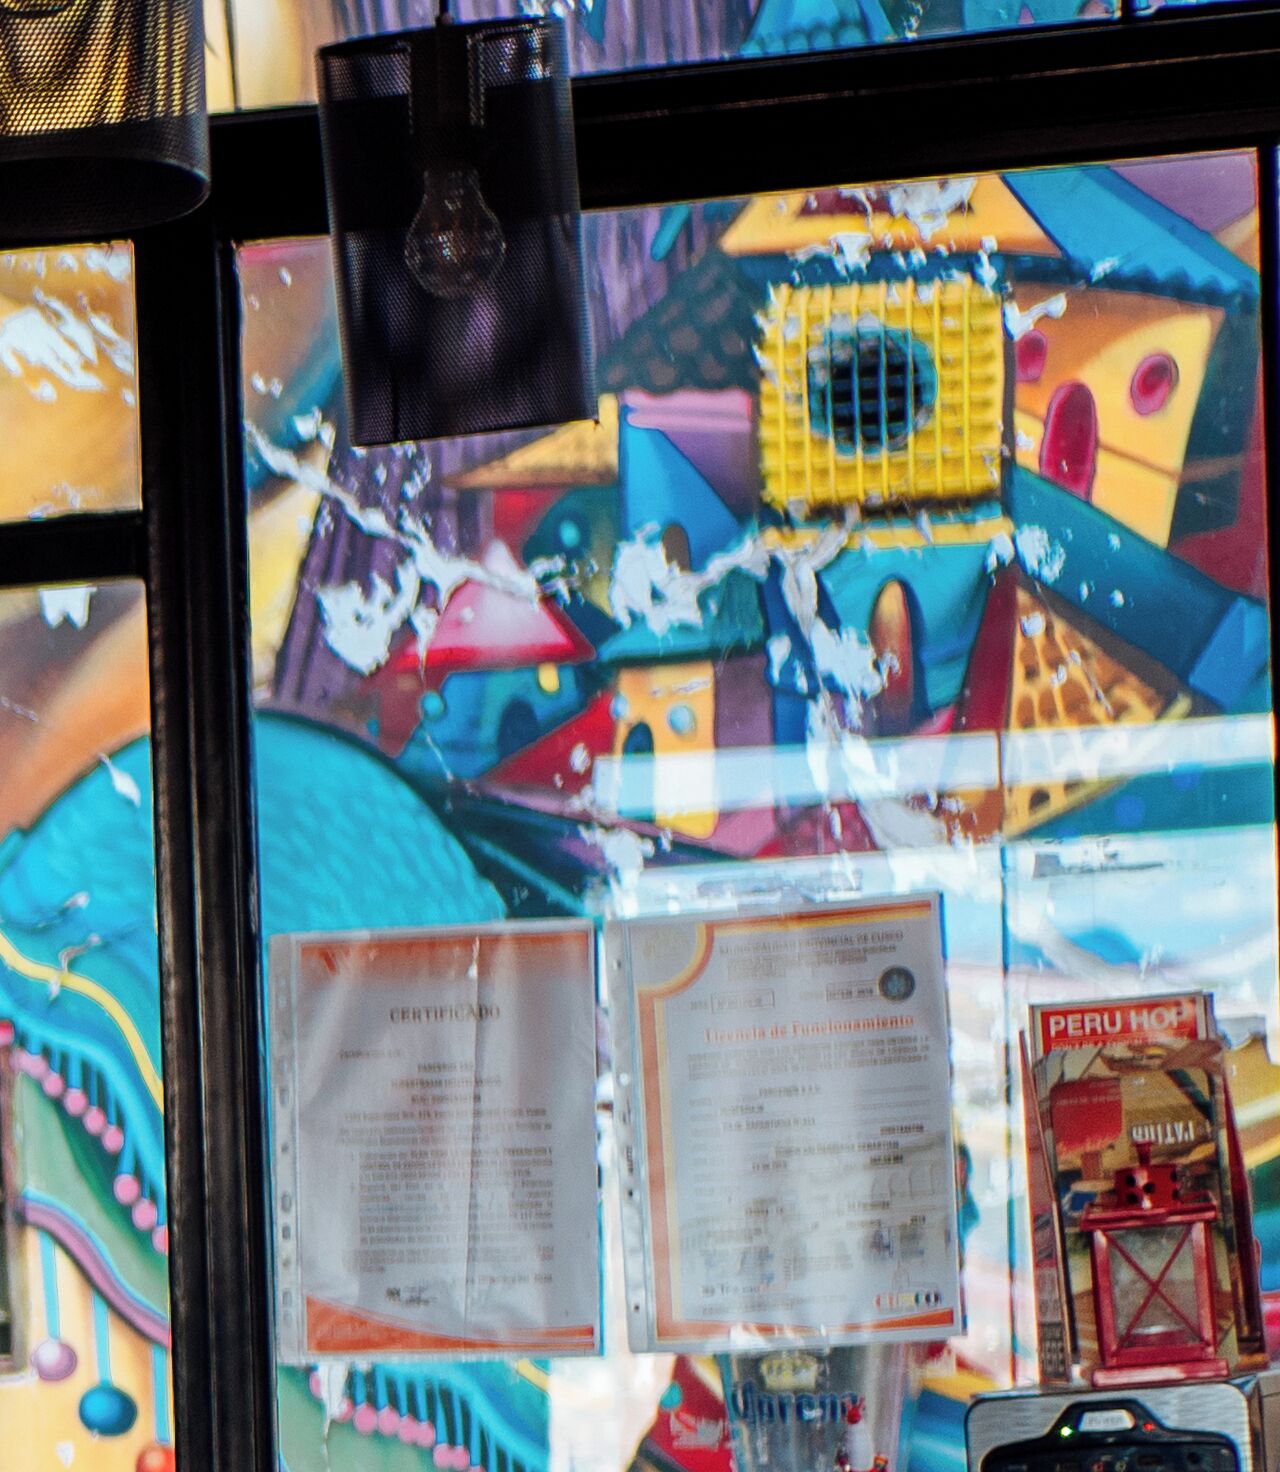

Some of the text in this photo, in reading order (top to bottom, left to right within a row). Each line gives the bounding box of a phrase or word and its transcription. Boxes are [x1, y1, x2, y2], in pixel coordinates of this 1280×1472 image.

[390, 1003, 500, 1024] CERTIFICADO
[1048, 1002, 1190, 1038] PERU HOP
